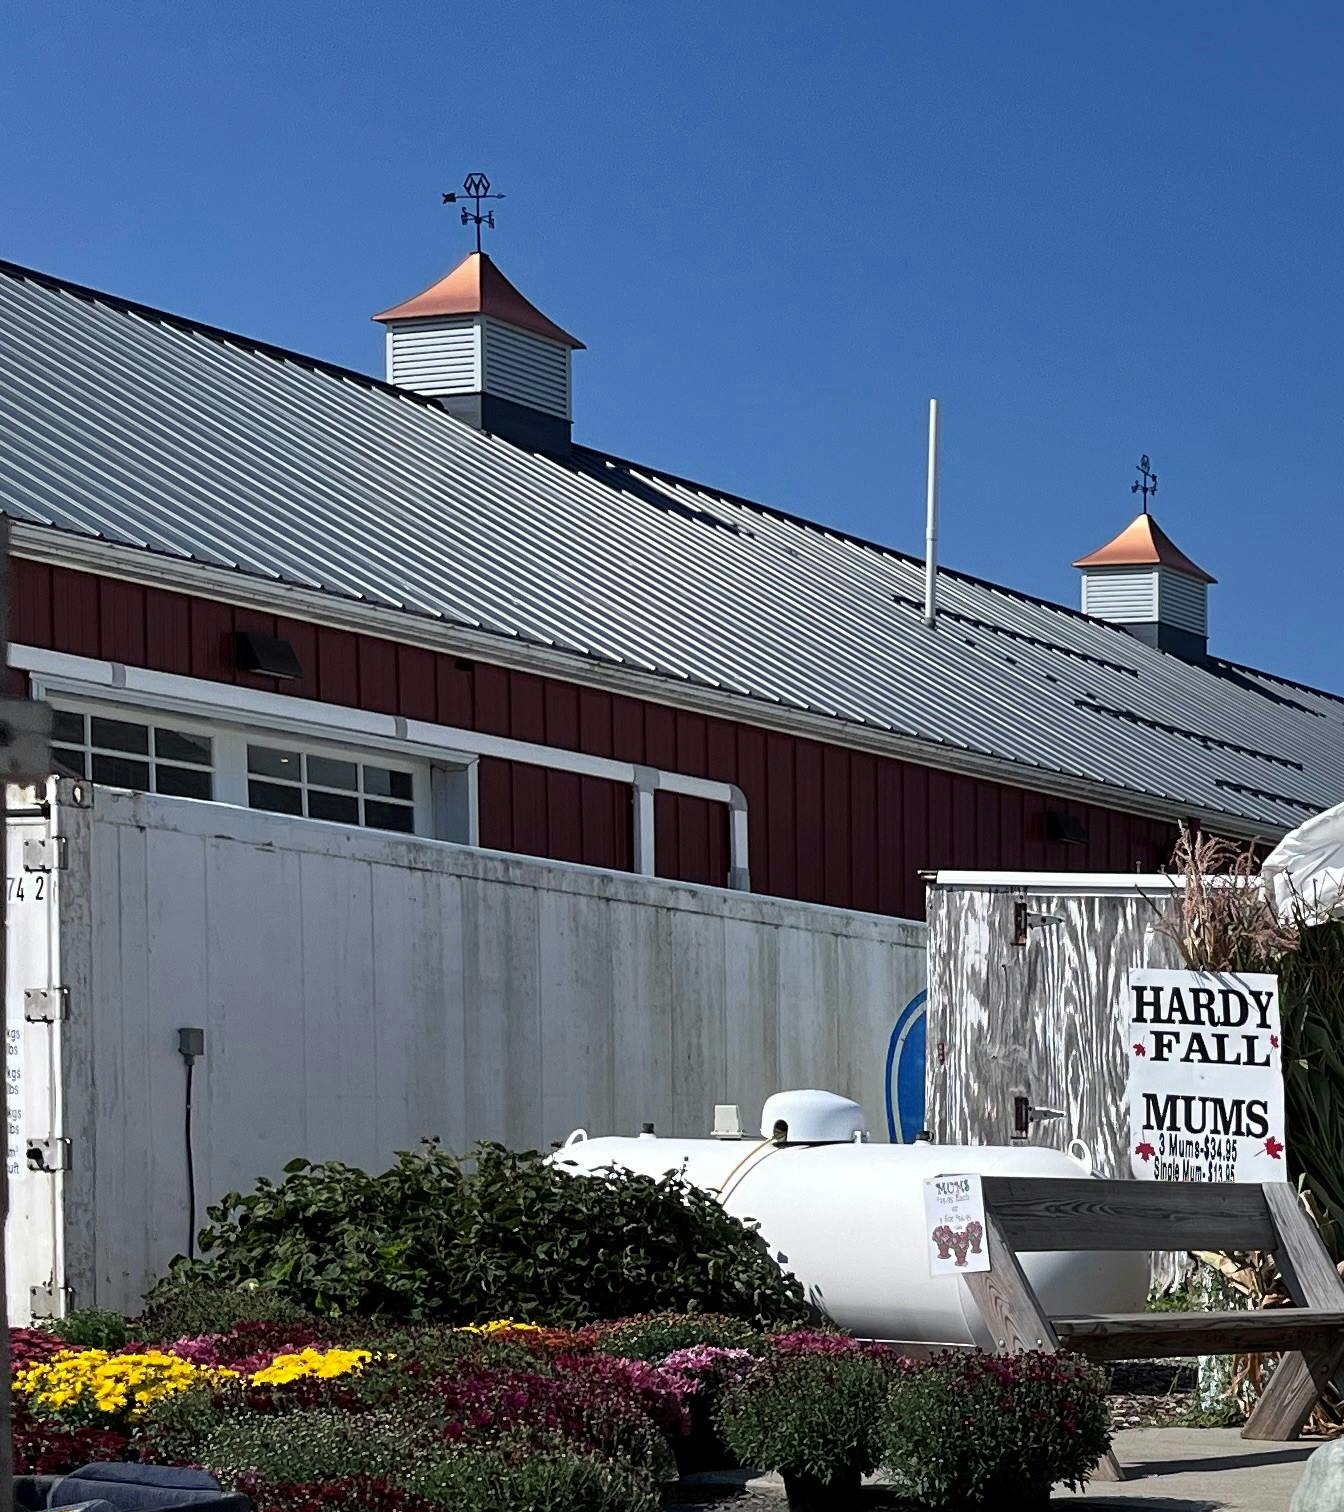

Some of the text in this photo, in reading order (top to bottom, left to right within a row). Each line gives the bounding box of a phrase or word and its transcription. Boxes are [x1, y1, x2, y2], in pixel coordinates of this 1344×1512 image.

[35, 875, 44, 901] 2
[1131, 985, 1274, 1030] HARDY
[1150, 1030, 1271, 1067] FALL
[1143, 1093, 1269, 1139] MUMS
[1159, 1132, 1166, 1156] 3
